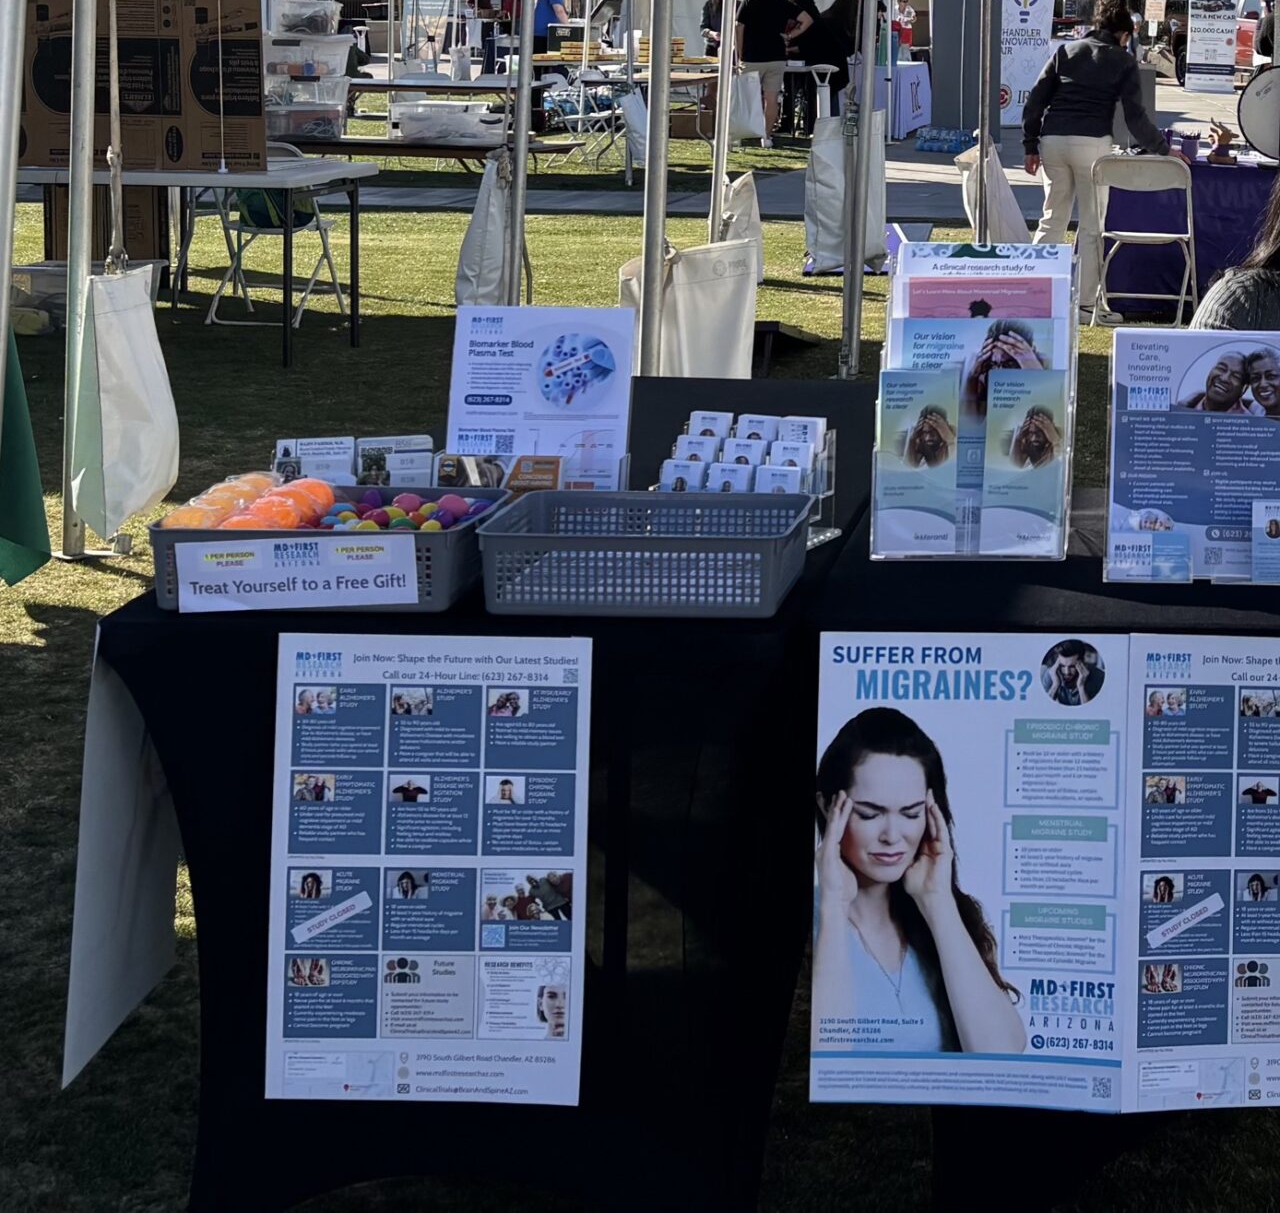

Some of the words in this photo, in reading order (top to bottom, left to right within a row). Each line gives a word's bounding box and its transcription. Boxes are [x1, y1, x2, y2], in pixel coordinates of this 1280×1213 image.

[931, 332, 955, 340] vision
[190, 581, 228, 595] Treat
[232, 577, 298, 593] Yourself
[302, 578, 318, 590] to
[322, 580, 331, 590] a
[336, 575, 368, 589] Free
[374, 573, 406, 588] Gift!
[833, 646, 914, 665] SUFFER
[921, 647, 981, 665] FROM
[1203, 656, 1219, 665] Join
[1222, 656, 1244, 664] Now:
[1246, 656, 1273, 666] Shape
[856, 669, 1033, 701] MIGRAINES?
[1231, 672, 1247, 681] Call
[1030, 979, 1057, 995] MD
[1070, 981, 1115, 999] FIRST
[1030, 996, 1113, 1015] RESEARCH
[1030, 1016, 1114, 1031] ARIZONA
[1046, 1037, 1069, 1049] (623)
[1072, 1038, 1113, 1051] 267-8314
